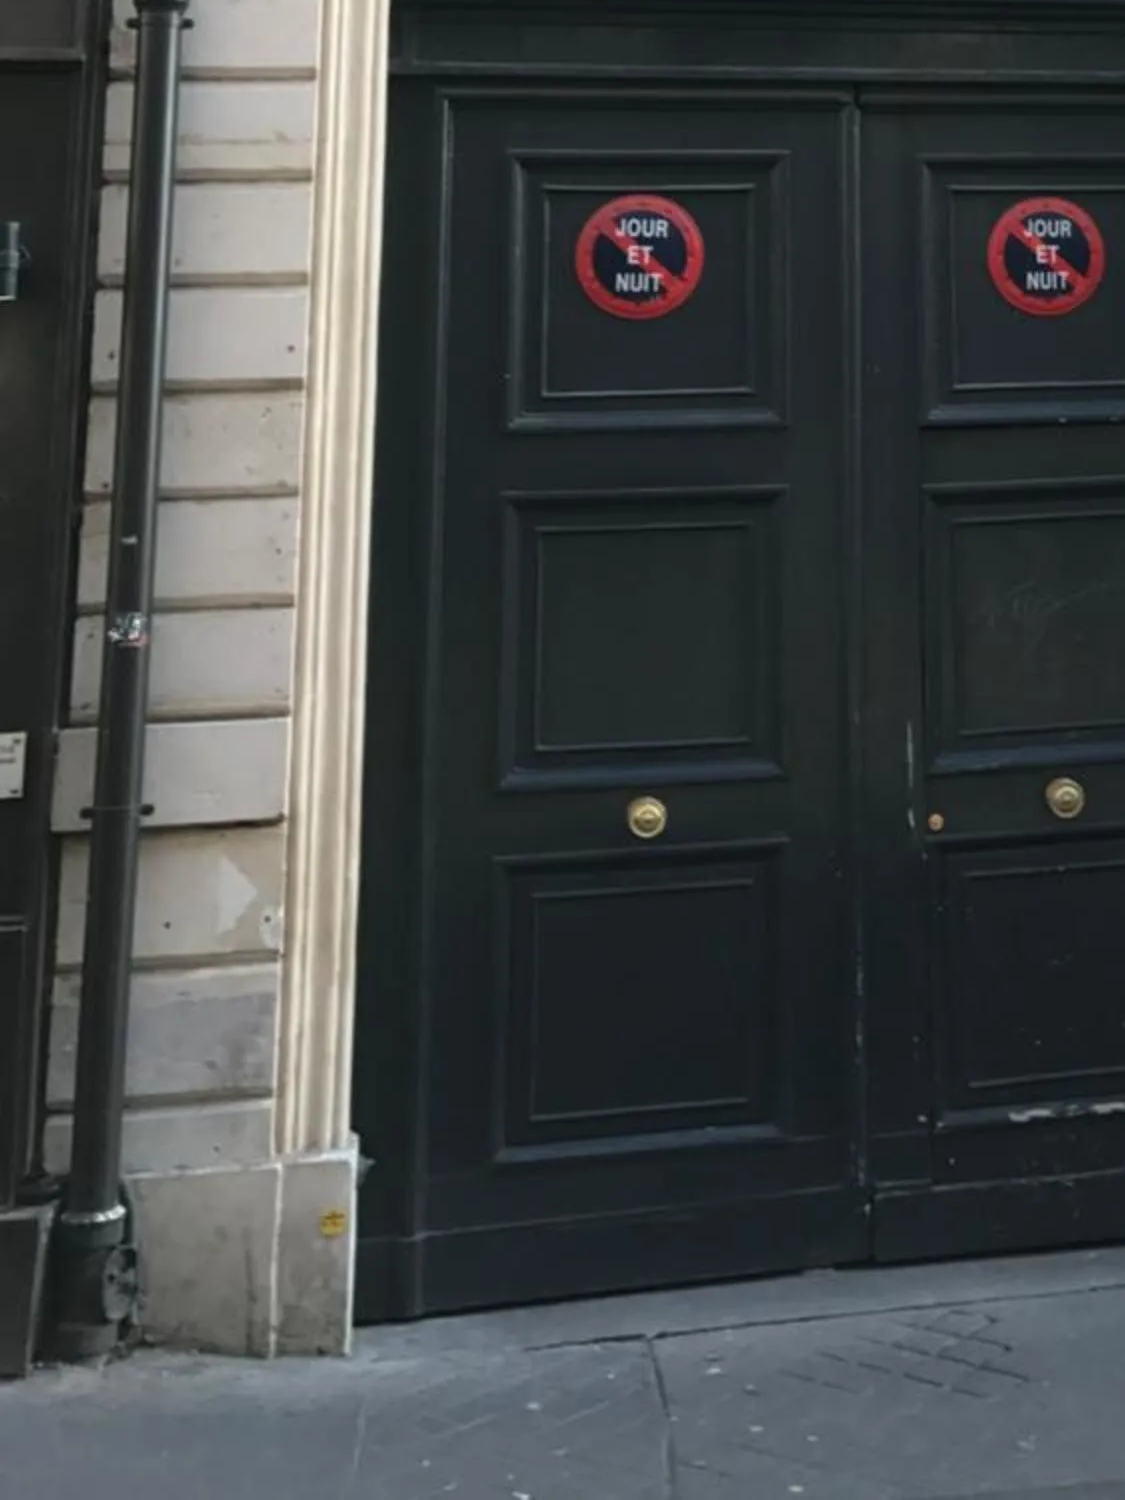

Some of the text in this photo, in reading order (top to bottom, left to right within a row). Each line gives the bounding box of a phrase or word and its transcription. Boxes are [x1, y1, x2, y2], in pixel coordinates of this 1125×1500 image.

[615, 218, 669, 238] JOUR
[1024, 219, 1071, 237] JOUR
[627, 245, 653, 265] ET
[1036, 245, 1060, 264] ET
[616, 273, 663, 292] NUIT
[1027, 272, 1069, 289] NUIT
